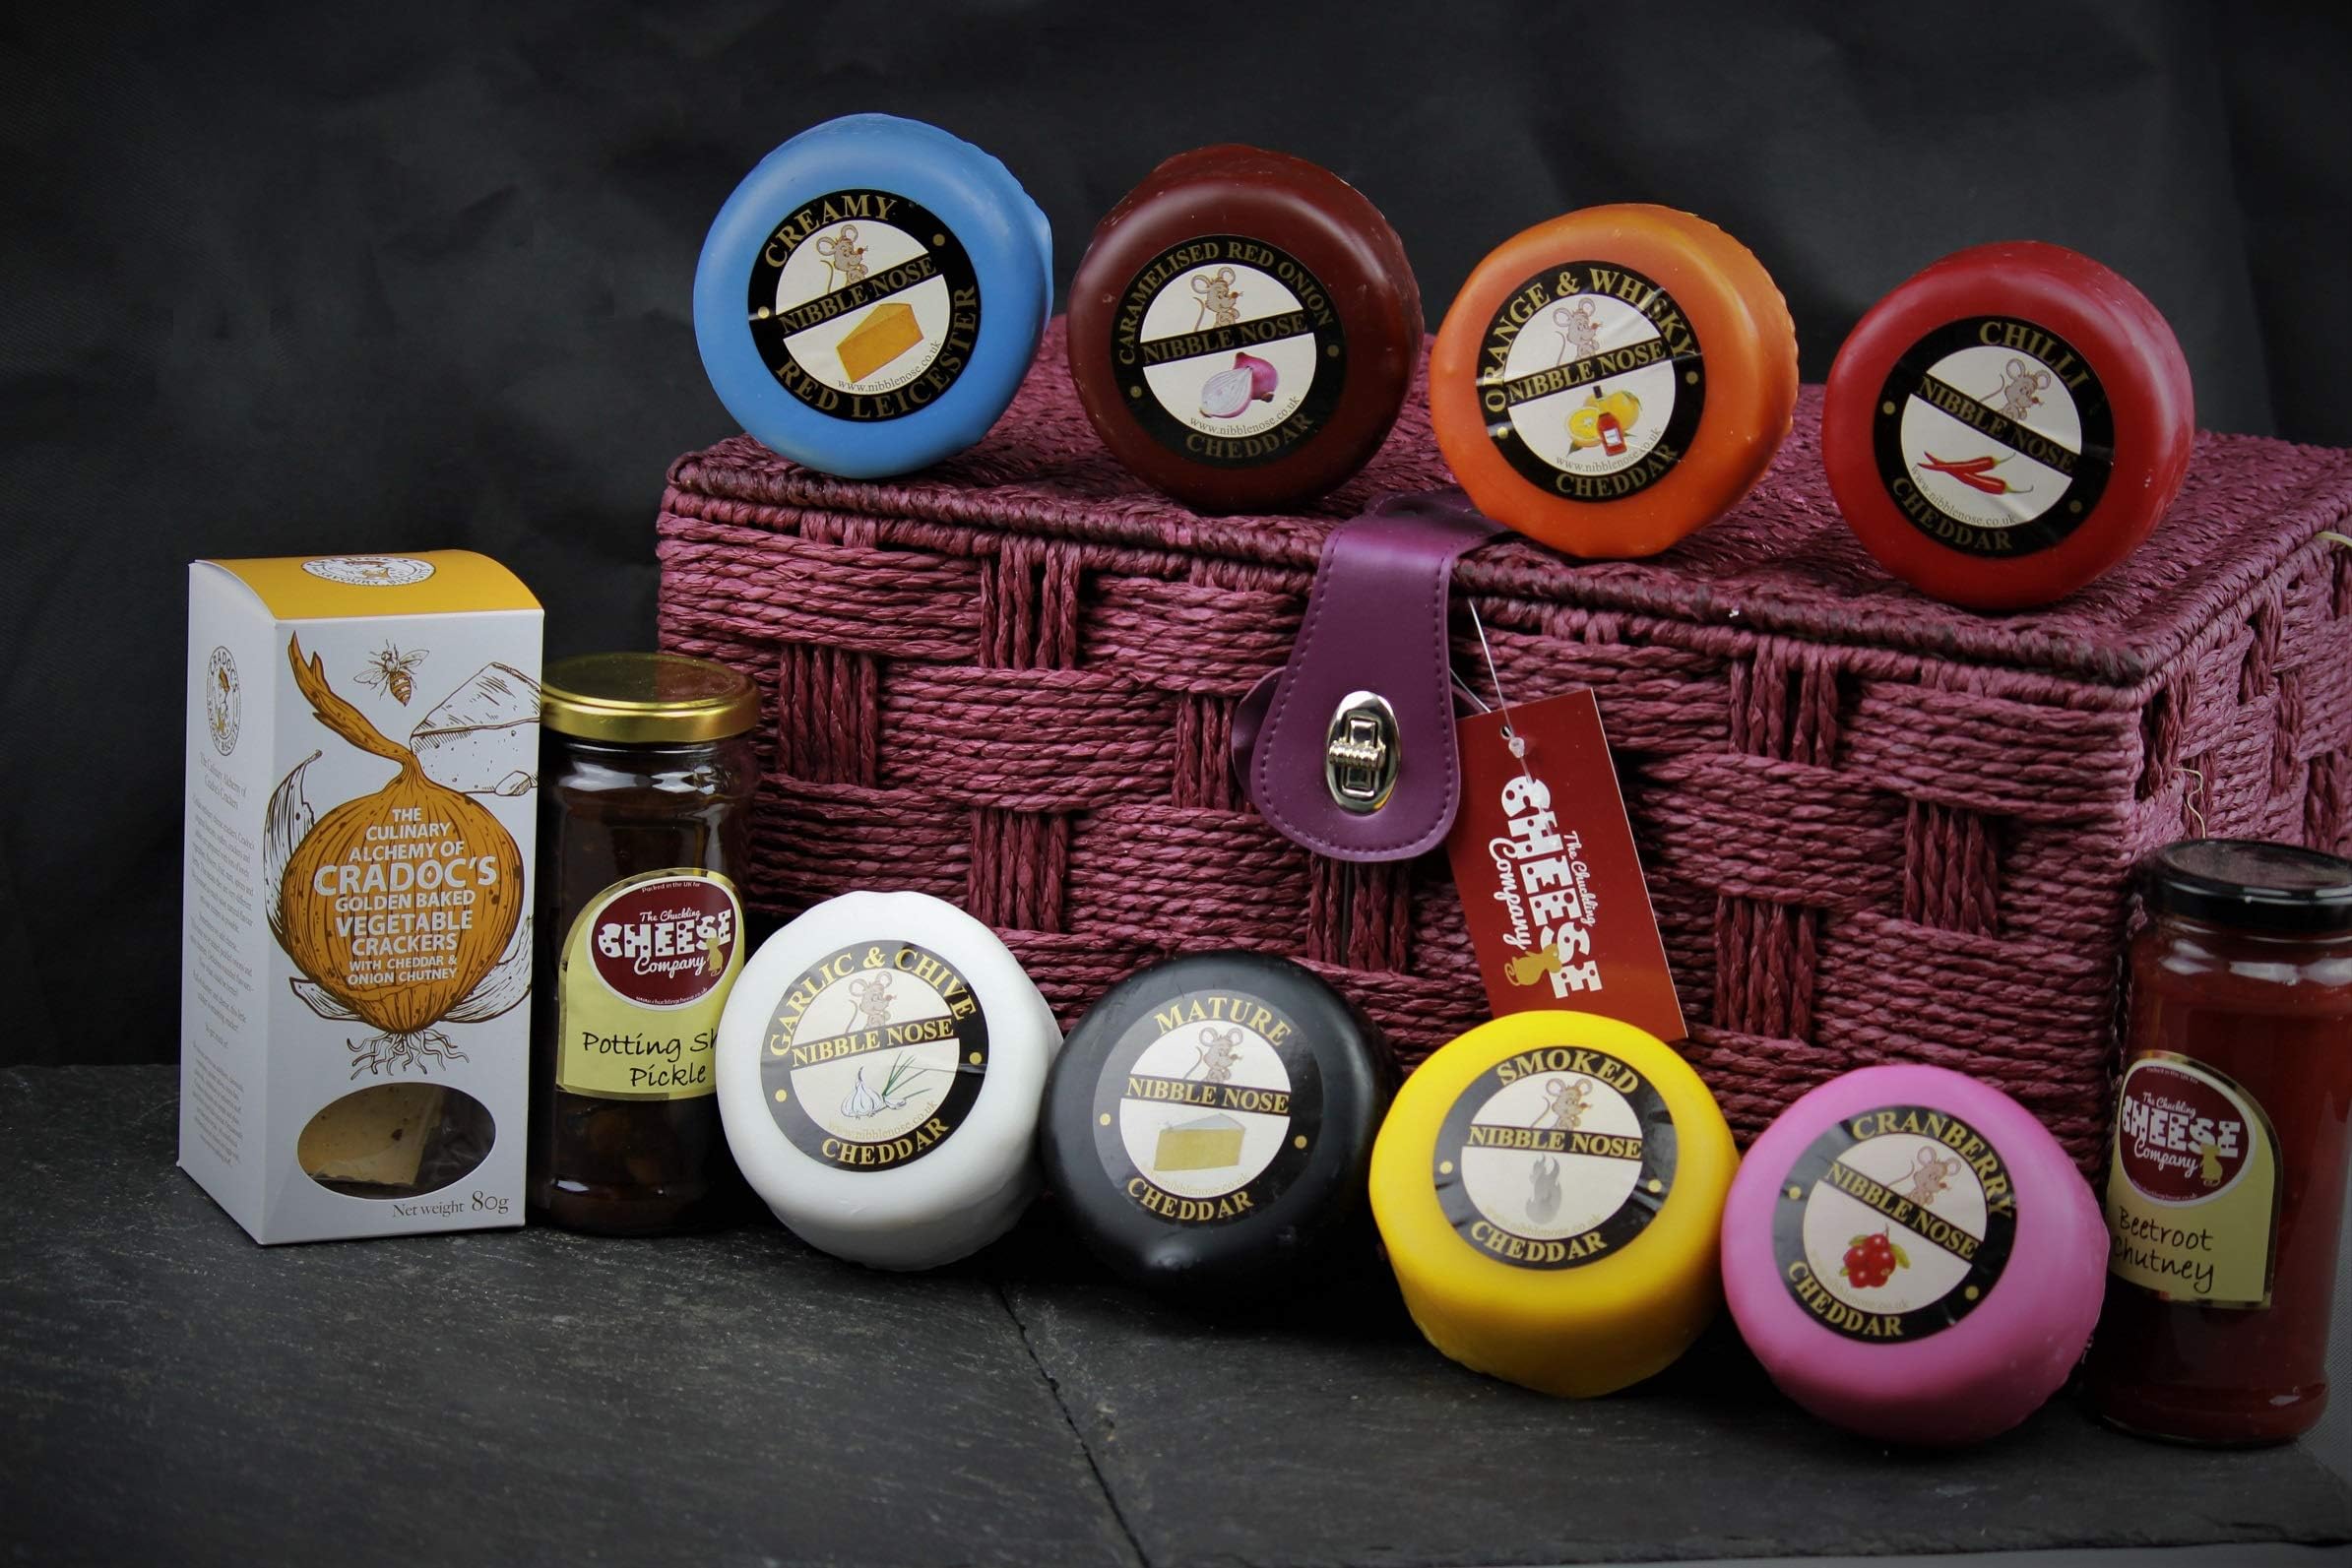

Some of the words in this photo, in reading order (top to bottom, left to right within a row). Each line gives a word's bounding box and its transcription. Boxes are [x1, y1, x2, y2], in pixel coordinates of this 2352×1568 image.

[765, 194, 897, 269] CREAMY
[780, 284, 868, 335] NIBBLE
[874, 256, 936, 296] NOSE
[1119, 241, 1220, 366] CARAMELISED
[1230, 241, 1276, 266] RED
[1278, 261, 1334, 327] ONION
[776, 357, 838, 412] RED
[851, 285, 978, 418] LEICESTER
[1143, 328, 1236, 364] NIBBLE
[1240, 313, 1307, 344] NOSE
[1484, 282, 1551, 412] ORANGE
[1556, 271, 1581, 296] &
[1589, 268, 1697, 357] WHISKY
[1979, 321, 2090, 391] CHILLI
[838, 339, 941, 393] www.nibblenose.co.uk
[1507, 361, 1599, 403] NIBBLE
[1601, 341, 1667, 376] NOSE
[1186, 412, 1314, 459] CHEDDAR
[1189, 396, 1302, 436] www.nibblenose.co.uk
[1918, 377, 2006, 439] NIBBLE
[2010, 426, 2077, 472] NOSE
[1556, 443, 1679, 497] CHEDDAR
[1892, 476, 2013, 550] CHEDDAR
[365, 822, 451, 842] CULINARY
[392, 807, 421, 822] THE
[349, 843, 438, 862] ALCHEMY
[440, 841, 465, 856] OF
[1563, 830, 1582, 859] The
[313, 856, 497, 897] CRADOC'S
[1489, 837, 1533, 952] Company
[1500, 776, 1603, 999] CHEESE
[1571, 860, 1598, 927] Chuckling
[335, 894, 411, 912] GOLDEN
[416, 890, 476, 909] BAKED
[335, 910, 473, 937] VEGETABLE
[640, 911, 658, 922] The
[660, 908, 701, 922] Chuckling
[351, 933, 458, 956] CRACKERS
[599, 909, 731, 958] CHEESE
[348, 972, 394, 985] ONION
[399, 968, 458, 981] CHUTNEY
[349, 960, 381, 972] WITH
[387, 956, 443, 969] CHEDDAR
[448, 956, 457, 966] &
[634, 955, 707, 978] Company
[770, 952, 855, 1056] GARLIC
[862, 947, 886, 970] &
[894, 948, 977, 1021] CHIVE
[1153, 997, 1292, 1046] MATURE
[582, 1032, 681, 1063] Potting
[792, 1030, 881, 1068] NIBBLE
[886, 1018, 954, 1045] NOSE
[629, 1063, 707, 1087] Pickle
[1125, 1077, 1217, 1104] NIBBLE
[1223, 1090, 1290, 1114] NOSE
[1496, 1049, 1639, 1095] SMOKED
[2123, 1095, 2241, 1159] CHEESE
[2142, 1091, 2155, 1106] The
[2156, 1097, 2196, 1118] Chuckling
[822, 1117, 949, 1165] CHEDDAR
[1468, 1126, 1566, 1150] NIBBLE
[1571, 1134, 1642, 1160] NOSE
[2133, 1139, 2200, 1179] Company
[1852, 1110, 2012, 1220] CRANBERRY
[393, 1204, 417, 1218] Net
[419, 1200, 465, 1218] weight
[472, 1190, 510, 1215] 80g
[1127, 1177, 1254, 1222] CHEDDAR
[1826, 1161, 1910, 1223] NIBBLE
[1912, 1210, 1979, 1260] NOSE
[1471, 1221, 1608, 1263] CHEDDAR
[2119, 1205, 2214, 1251] Beetroot
[1788, 1261, 1903, 1337] CHEDDAR
